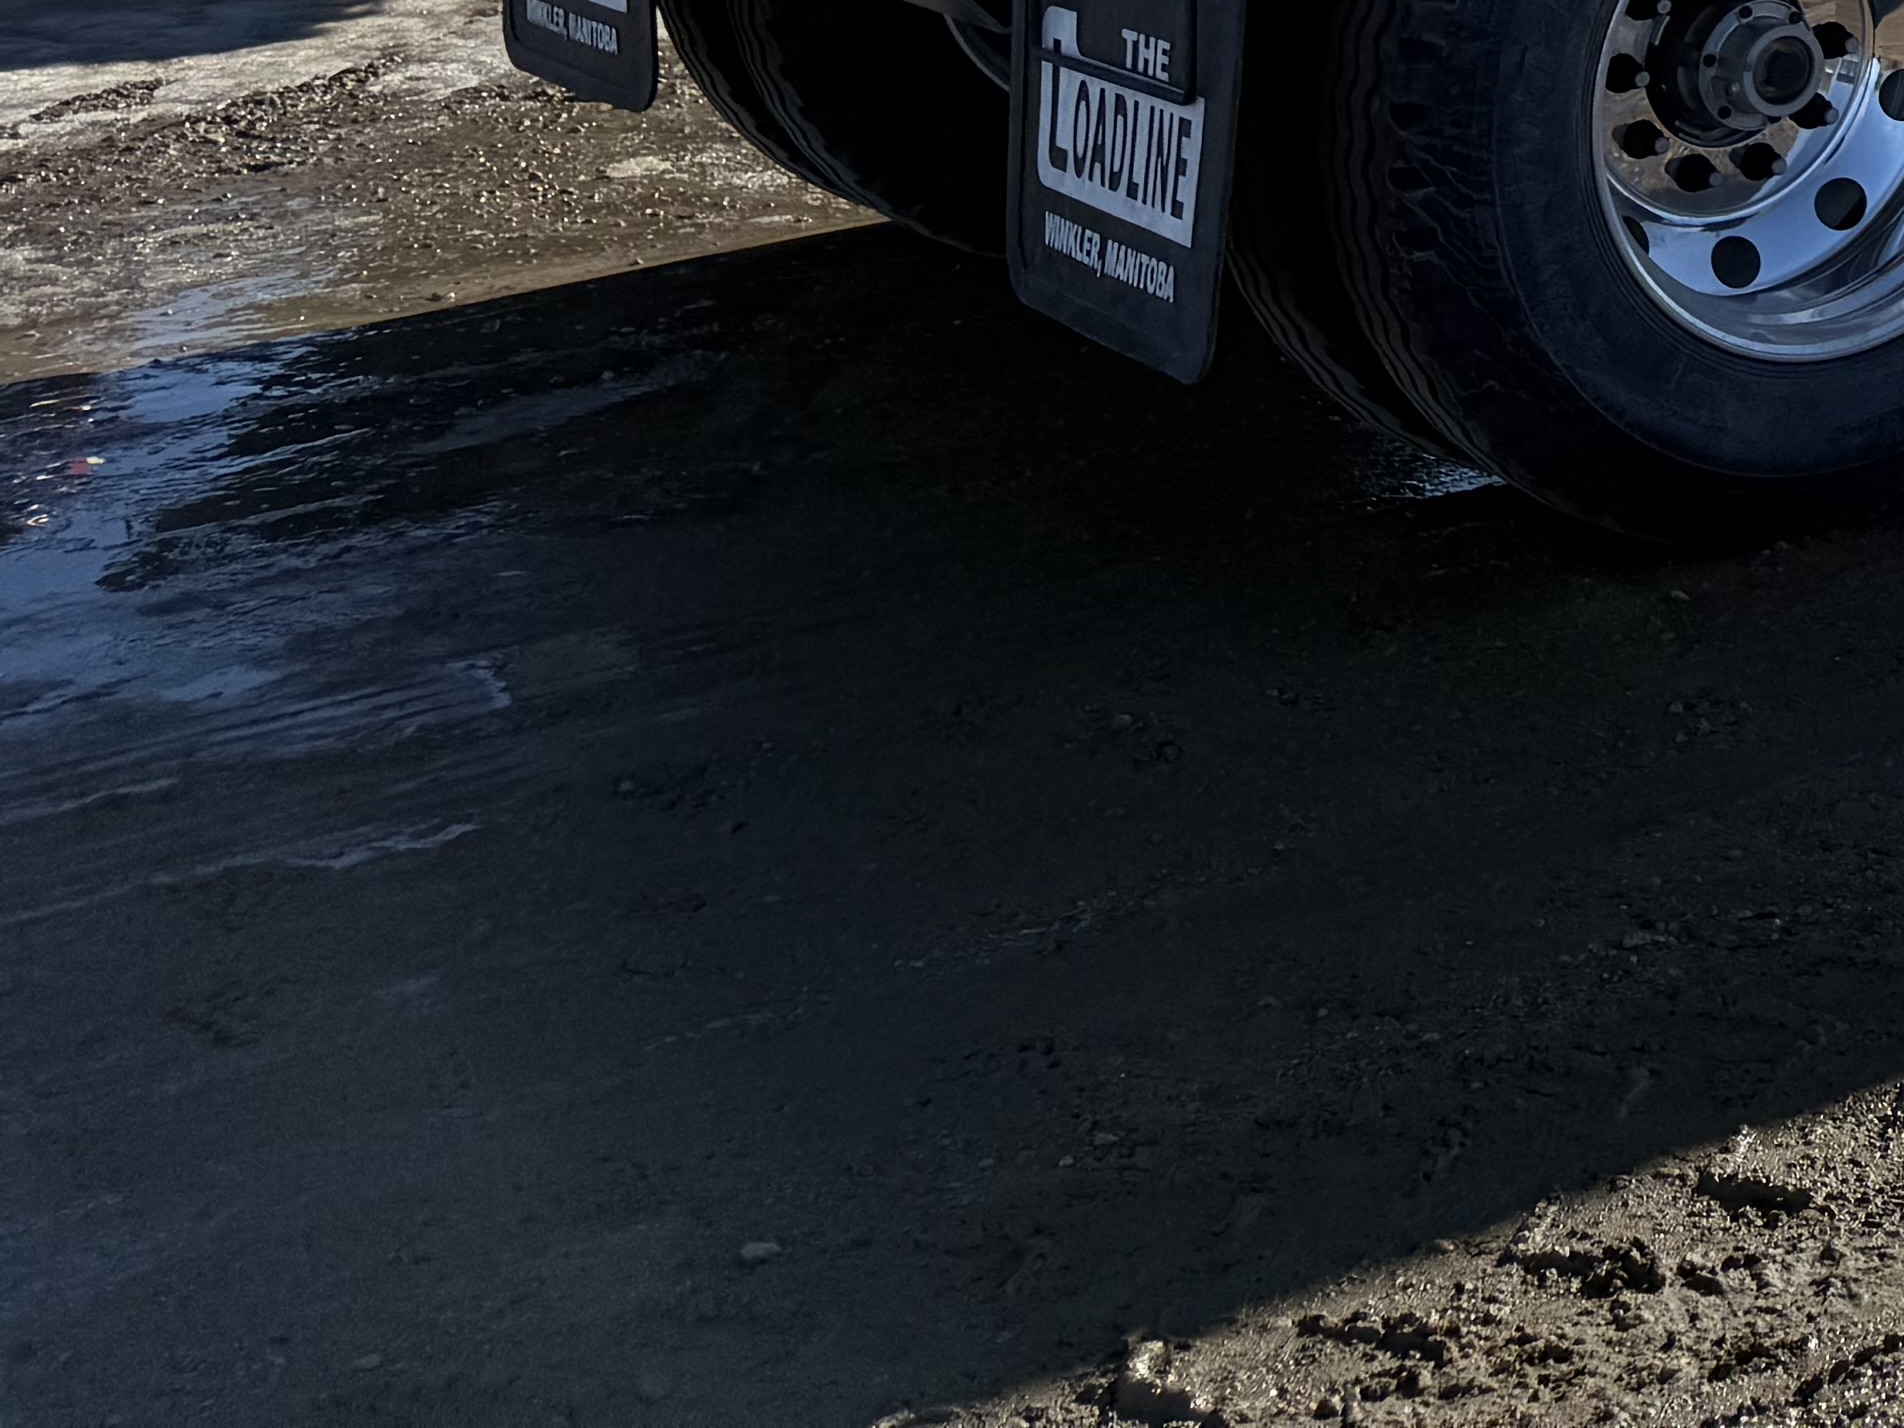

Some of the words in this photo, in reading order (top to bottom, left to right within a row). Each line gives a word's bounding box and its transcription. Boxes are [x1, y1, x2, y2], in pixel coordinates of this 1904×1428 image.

[1121, 29, 1170, 82] THE
[1049, 37, 1193, 221] LOADLINE
[1045, 210, 1102, 277] WINKLER,
[1103, 239, 1174, 303] MANITOBA
